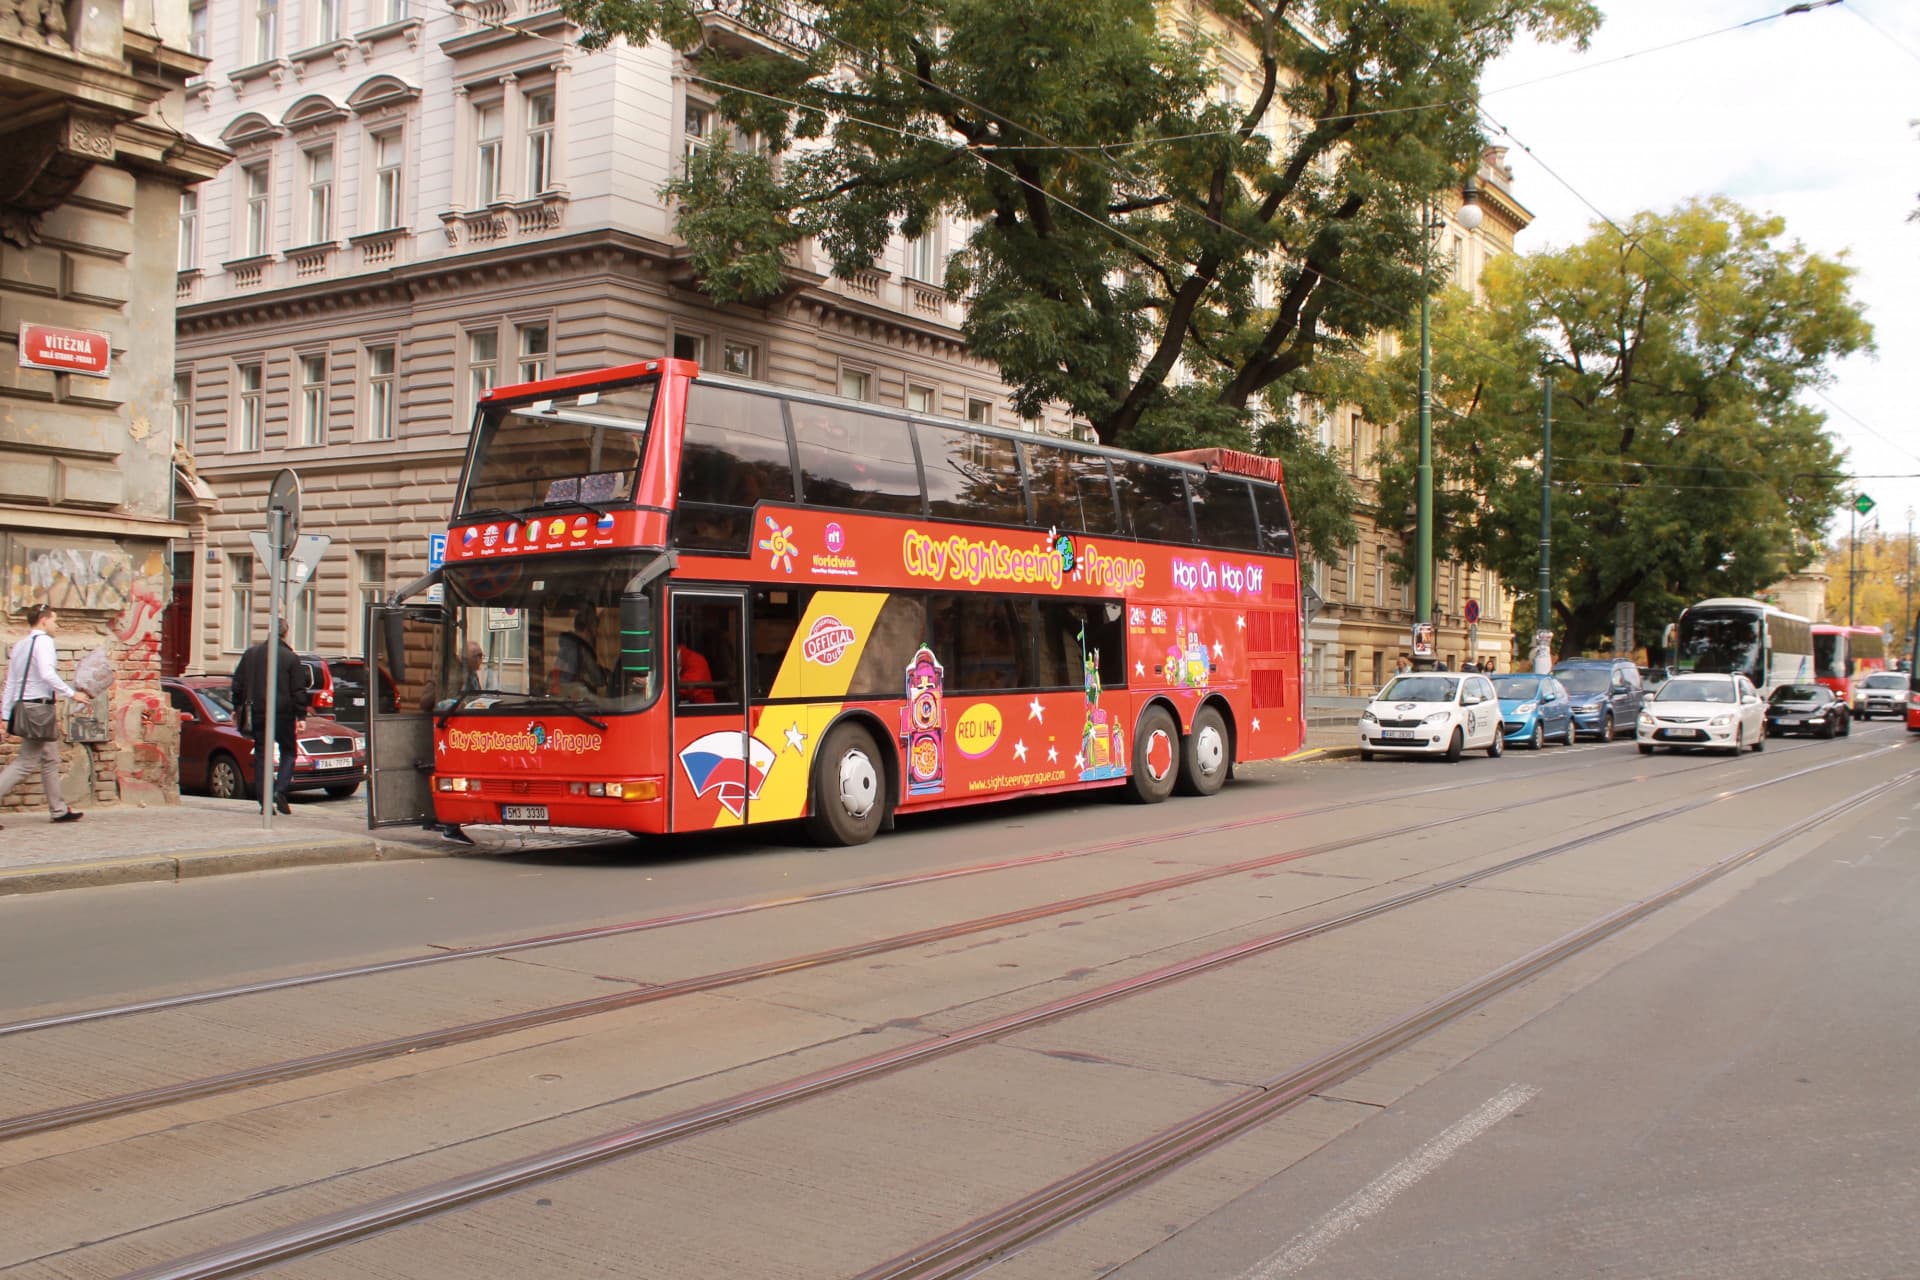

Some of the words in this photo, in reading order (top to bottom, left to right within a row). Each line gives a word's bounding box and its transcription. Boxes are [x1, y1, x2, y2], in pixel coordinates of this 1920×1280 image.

[1085, 544, 1145, 592] Prague
[1173, 560, 1198, 590] Hop
[1200, 561, 1217, 588] On
[1221, 565, 1244, 592] Hop
[1246, 566, 1263, 591] Off
[808, 629, 854, 656] OFFICIAL
[823, 648, 842, 661] TOUR
[959, 721, 976, 738] RED
[979, 720, 997, 737] LINE
[554, 729, 602, 754] Prague
[968, 770, 1066, 791] www.sightseeingprague.com
[507, 807, 521, 819] 5M3
[526, 808, 545, 819] 3330
